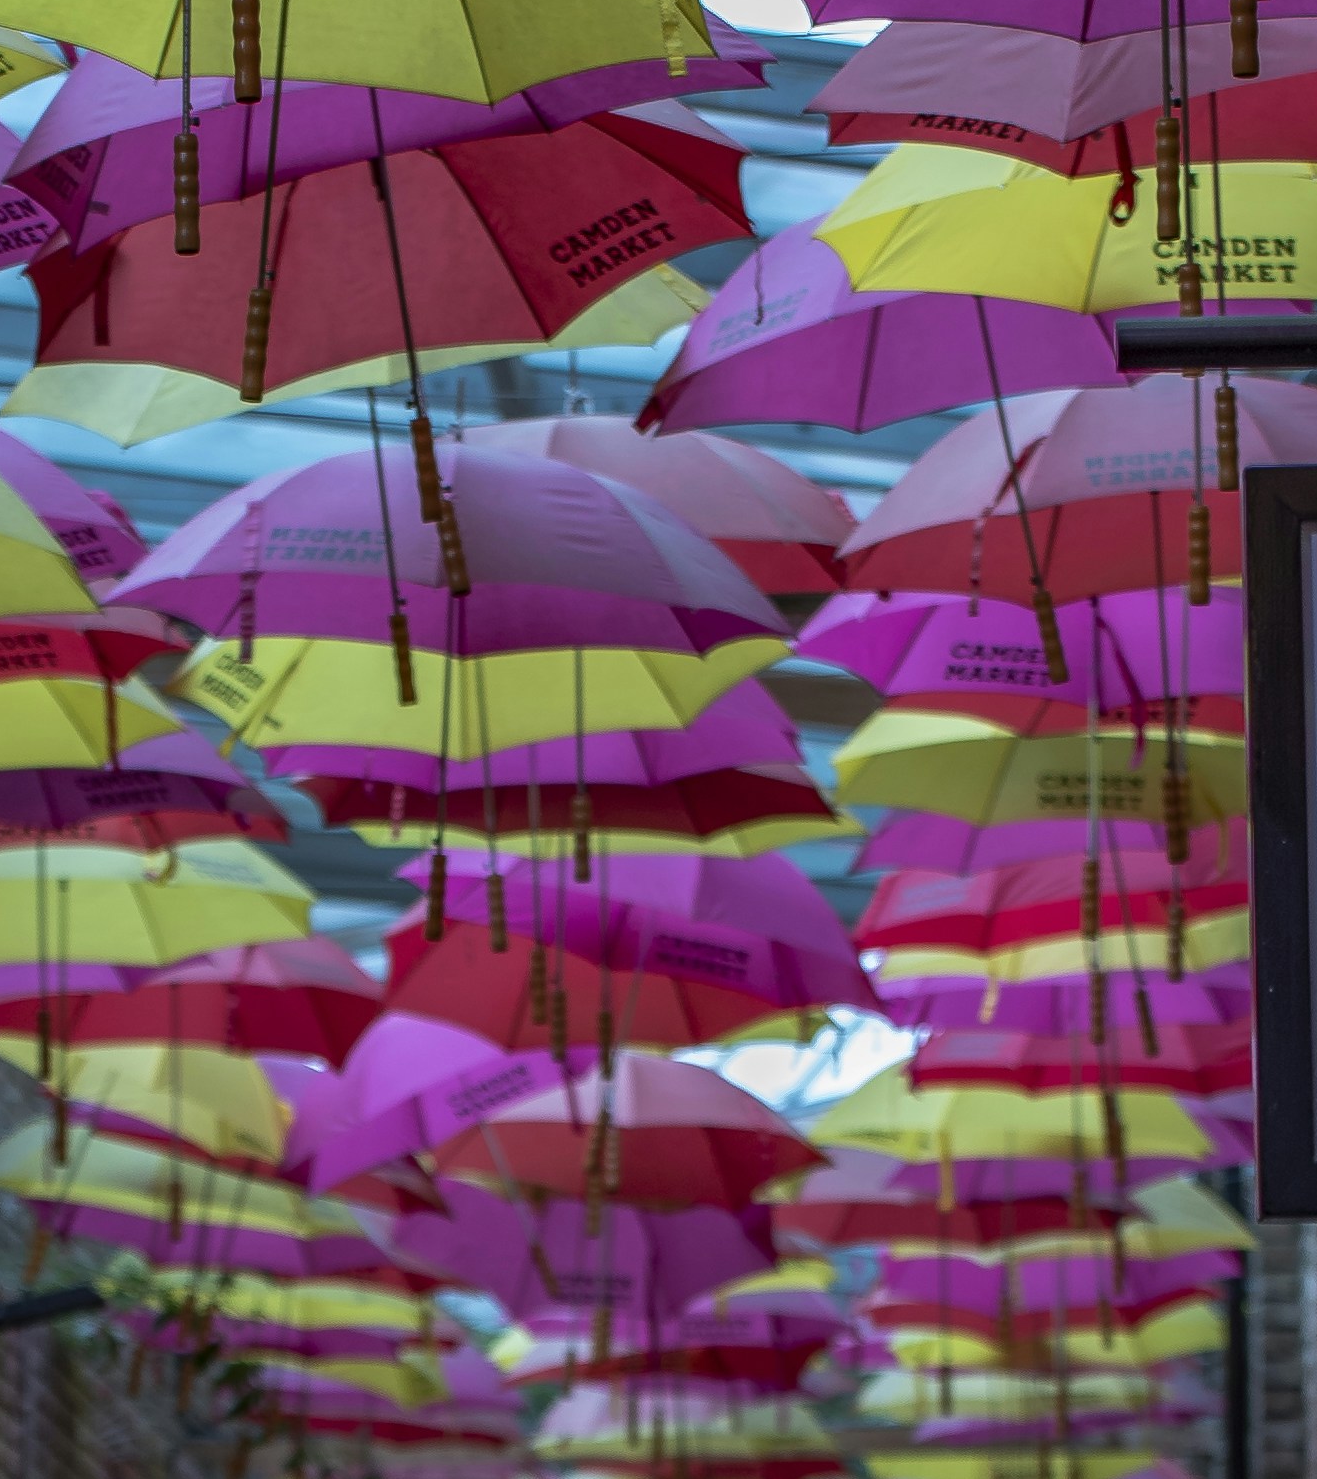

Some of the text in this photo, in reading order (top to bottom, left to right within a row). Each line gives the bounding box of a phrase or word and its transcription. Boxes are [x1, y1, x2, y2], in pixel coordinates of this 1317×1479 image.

[548, 198, 660, 265] CAMDEN
[567, 222, 677, 288] MARKET
[949, 640, 1046, 663] CAMDE
